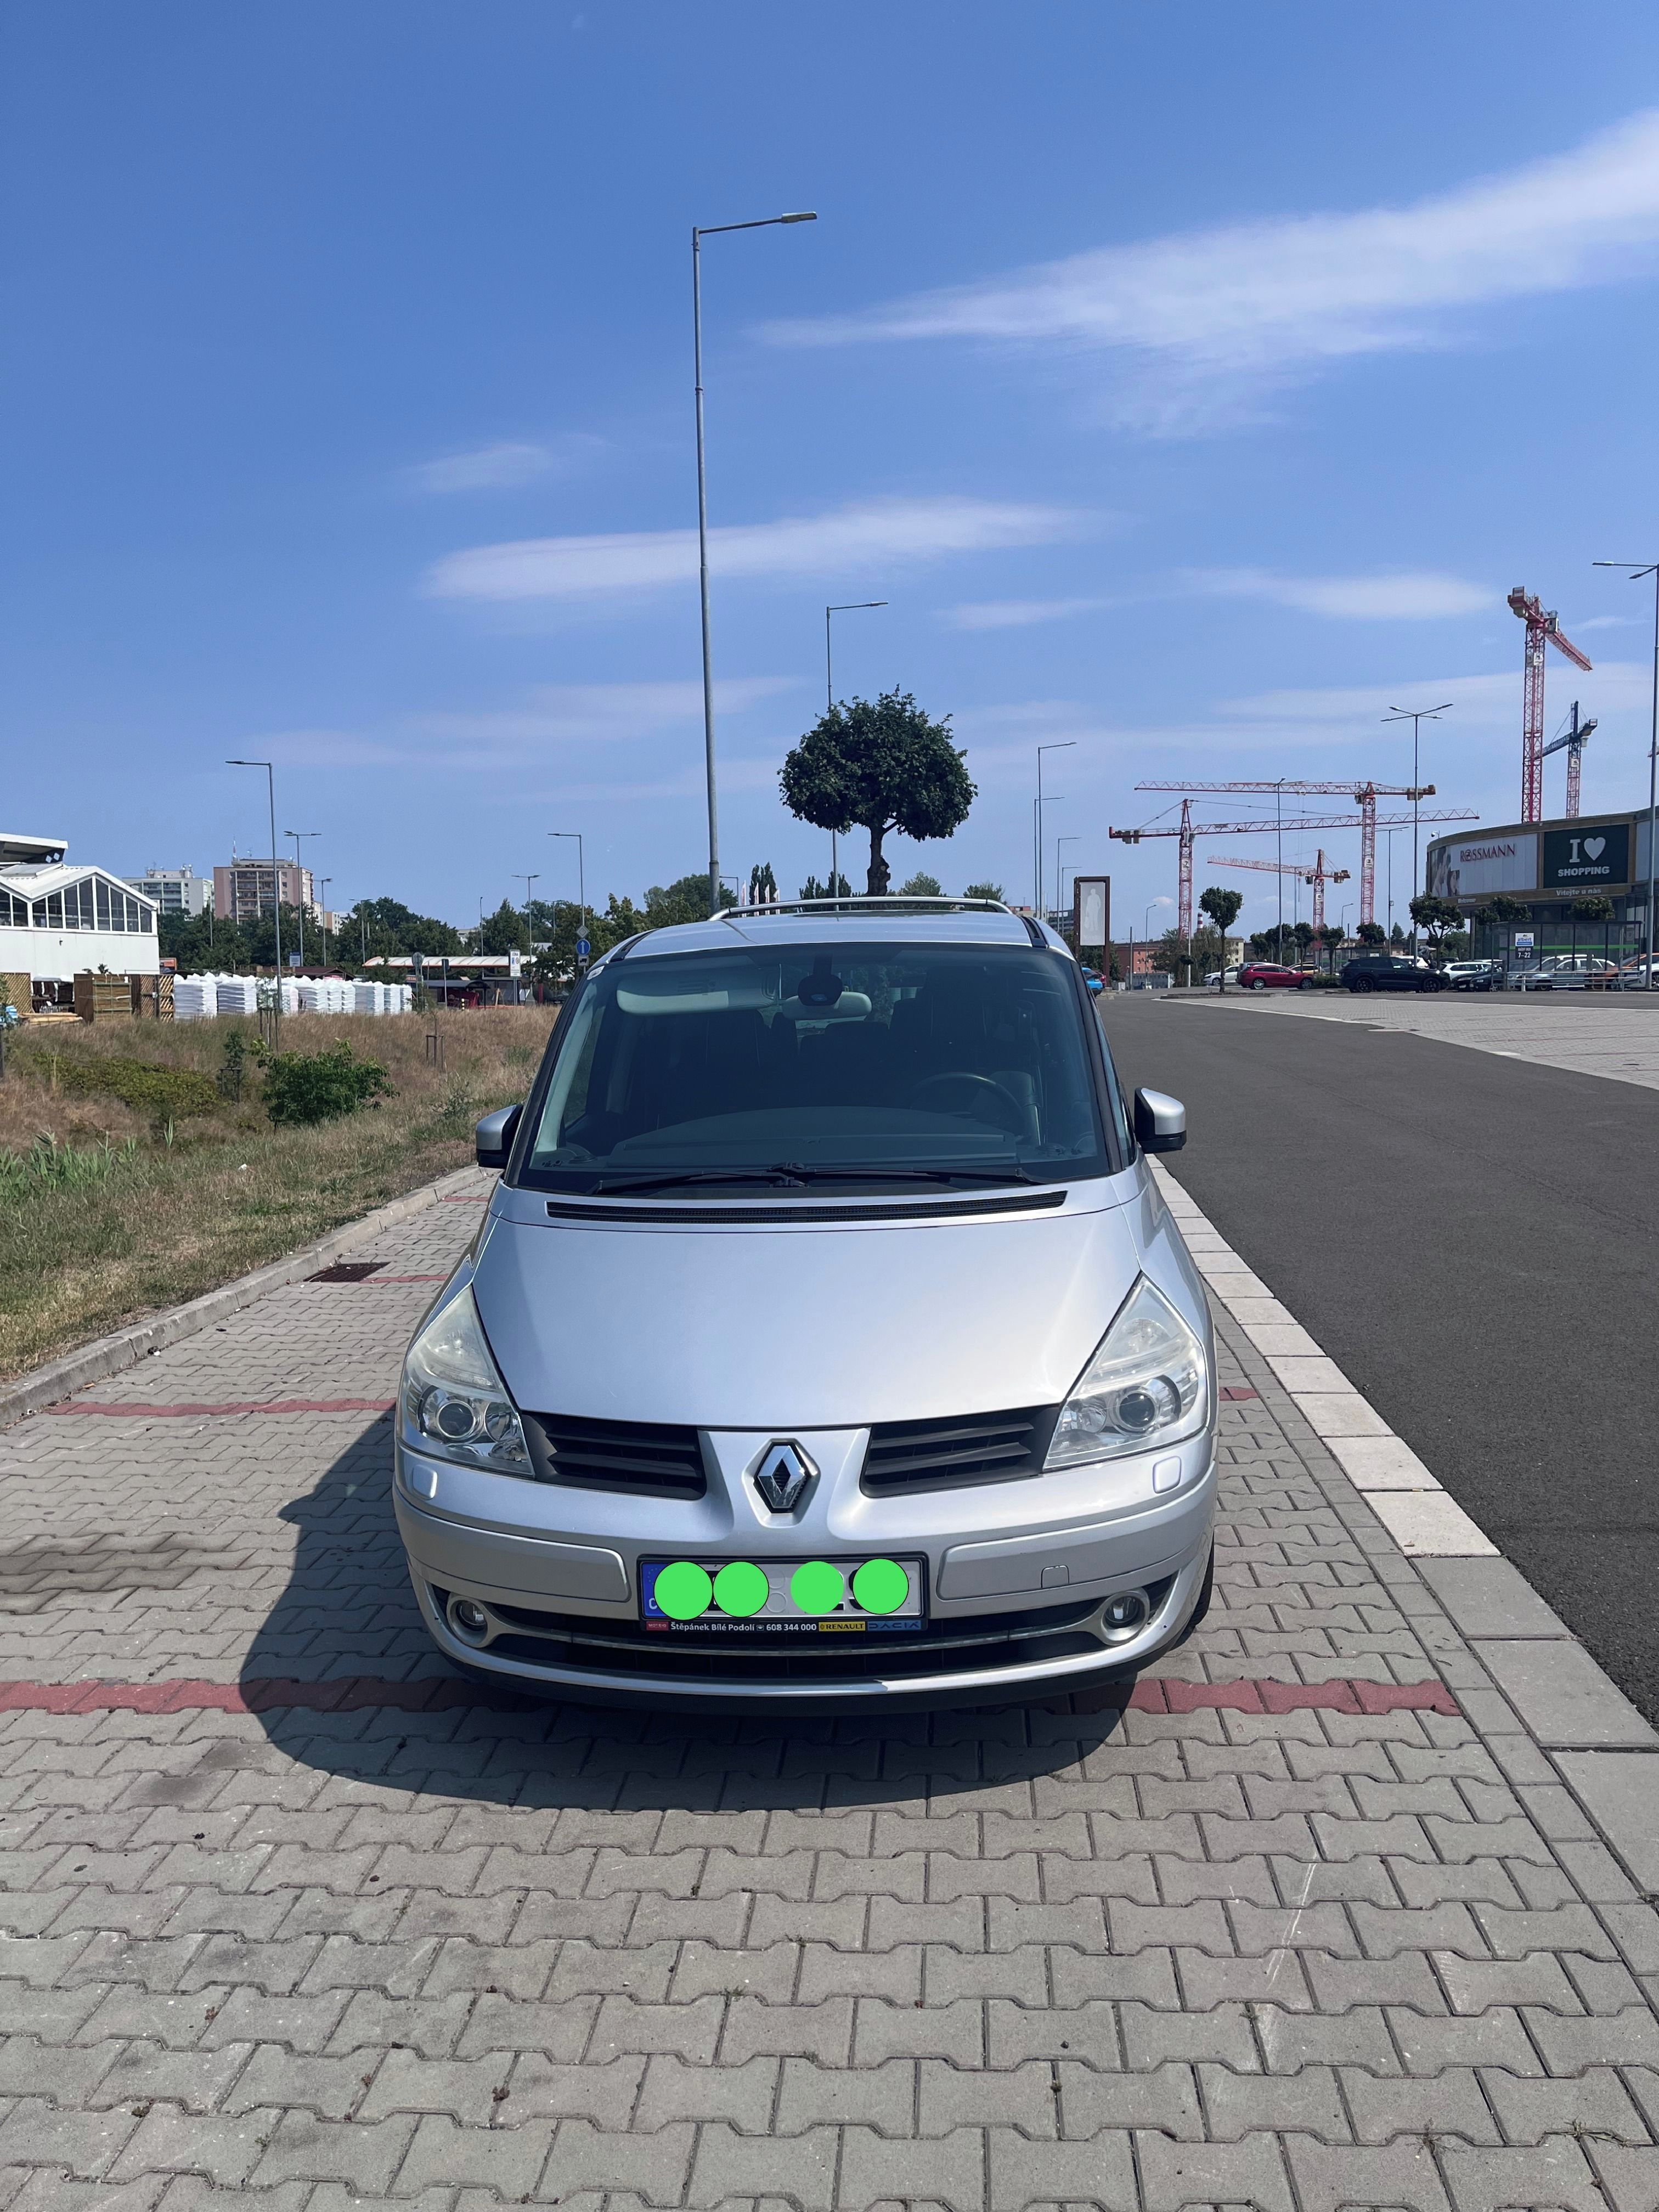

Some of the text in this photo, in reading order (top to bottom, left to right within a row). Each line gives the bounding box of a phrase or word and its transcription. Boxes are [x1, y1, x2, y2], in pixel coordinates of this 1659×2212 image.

[1460, 844, 1516, 862] ROSSMANN
[1570, 839, 1581, 863] I
[1558, 866, 1610, 877] SHOPPING
[670, 1622, 710, 1631] Štěpánek
